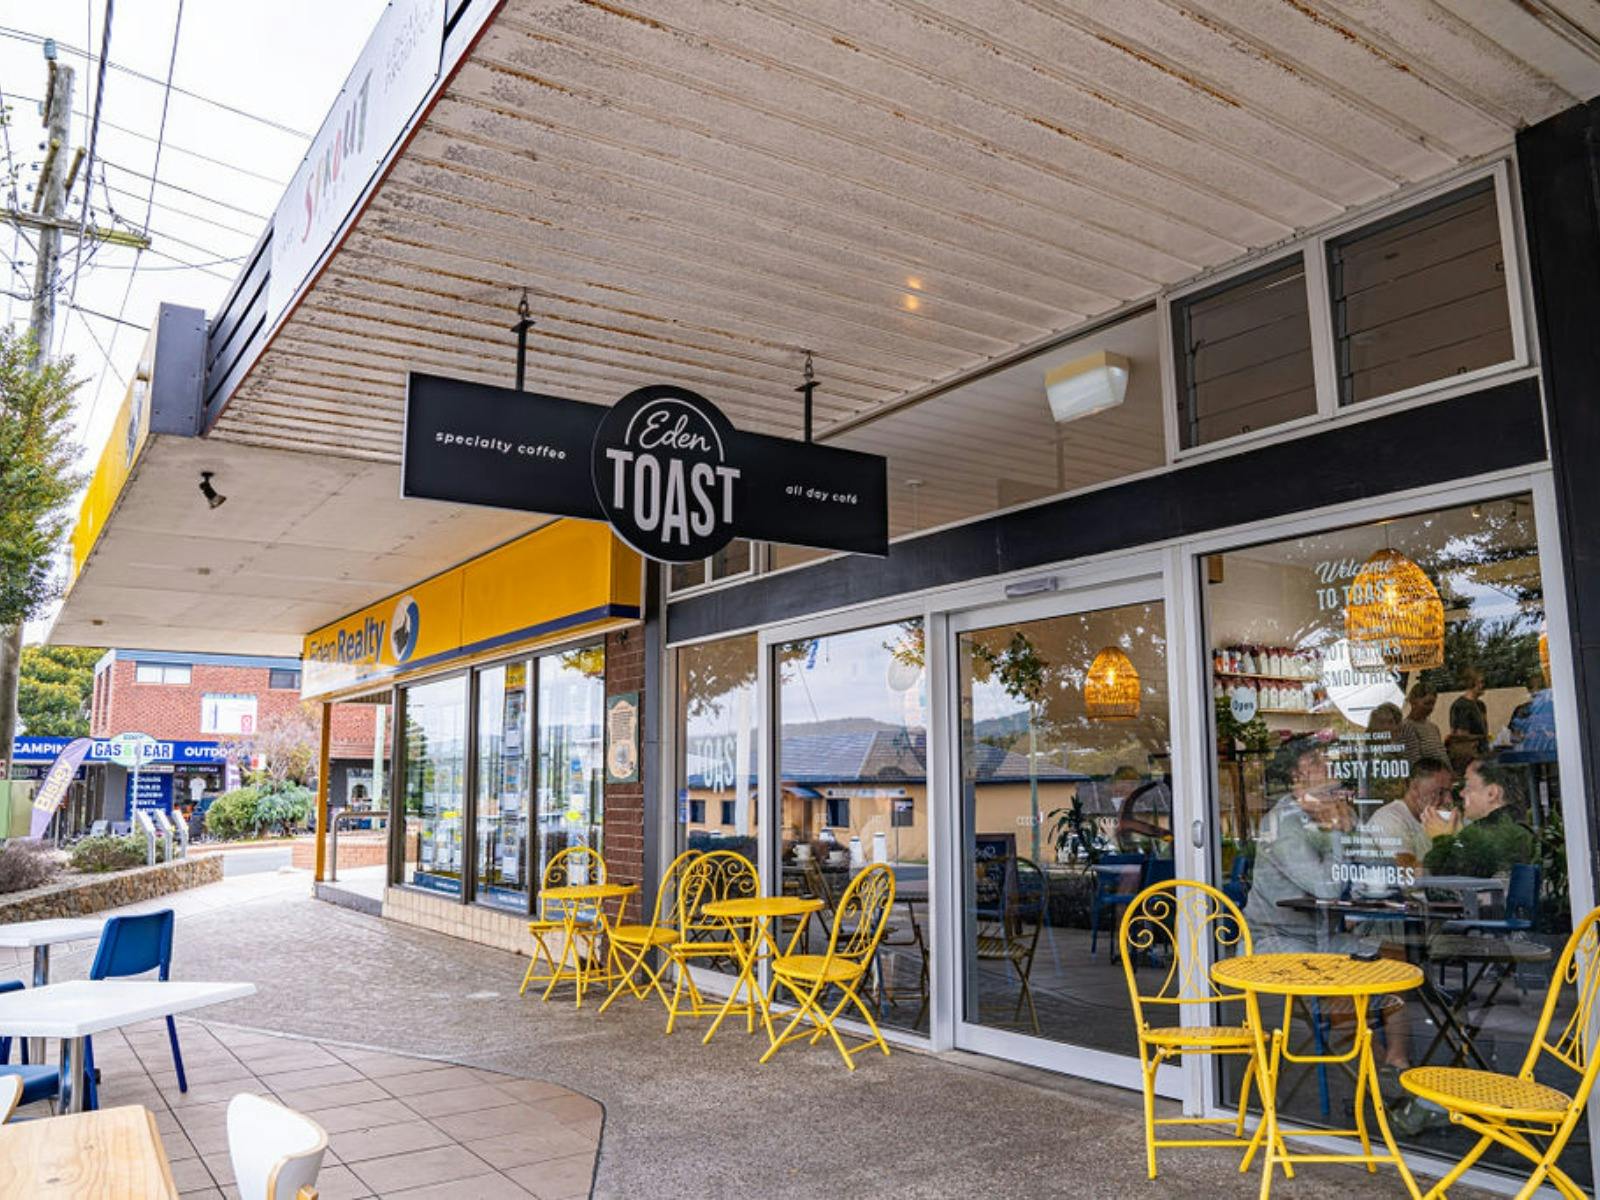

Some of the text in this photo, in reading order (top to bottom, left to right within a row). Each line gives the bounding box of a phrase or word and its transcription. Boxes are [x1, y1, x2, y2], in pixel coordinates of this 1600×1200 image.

[639, 410, 712, 452] Eden
[434, 431, 567, 460] specialty coffee
[606, 447, 741, 545] TOAST
[785, 484, 803, 496] all
[806, 486, 829, 502] day
[1316, 587, 1338, 610] TO
[337, 616, 386, 664] Realty
[1232, 699, 1255, 712] Open
[13, 742, 66, 755] CAMPIN
[1326, 758, 1410, 779] TASTY FOOD
[1331, 863, 1415, 886] GOOD VIBES
